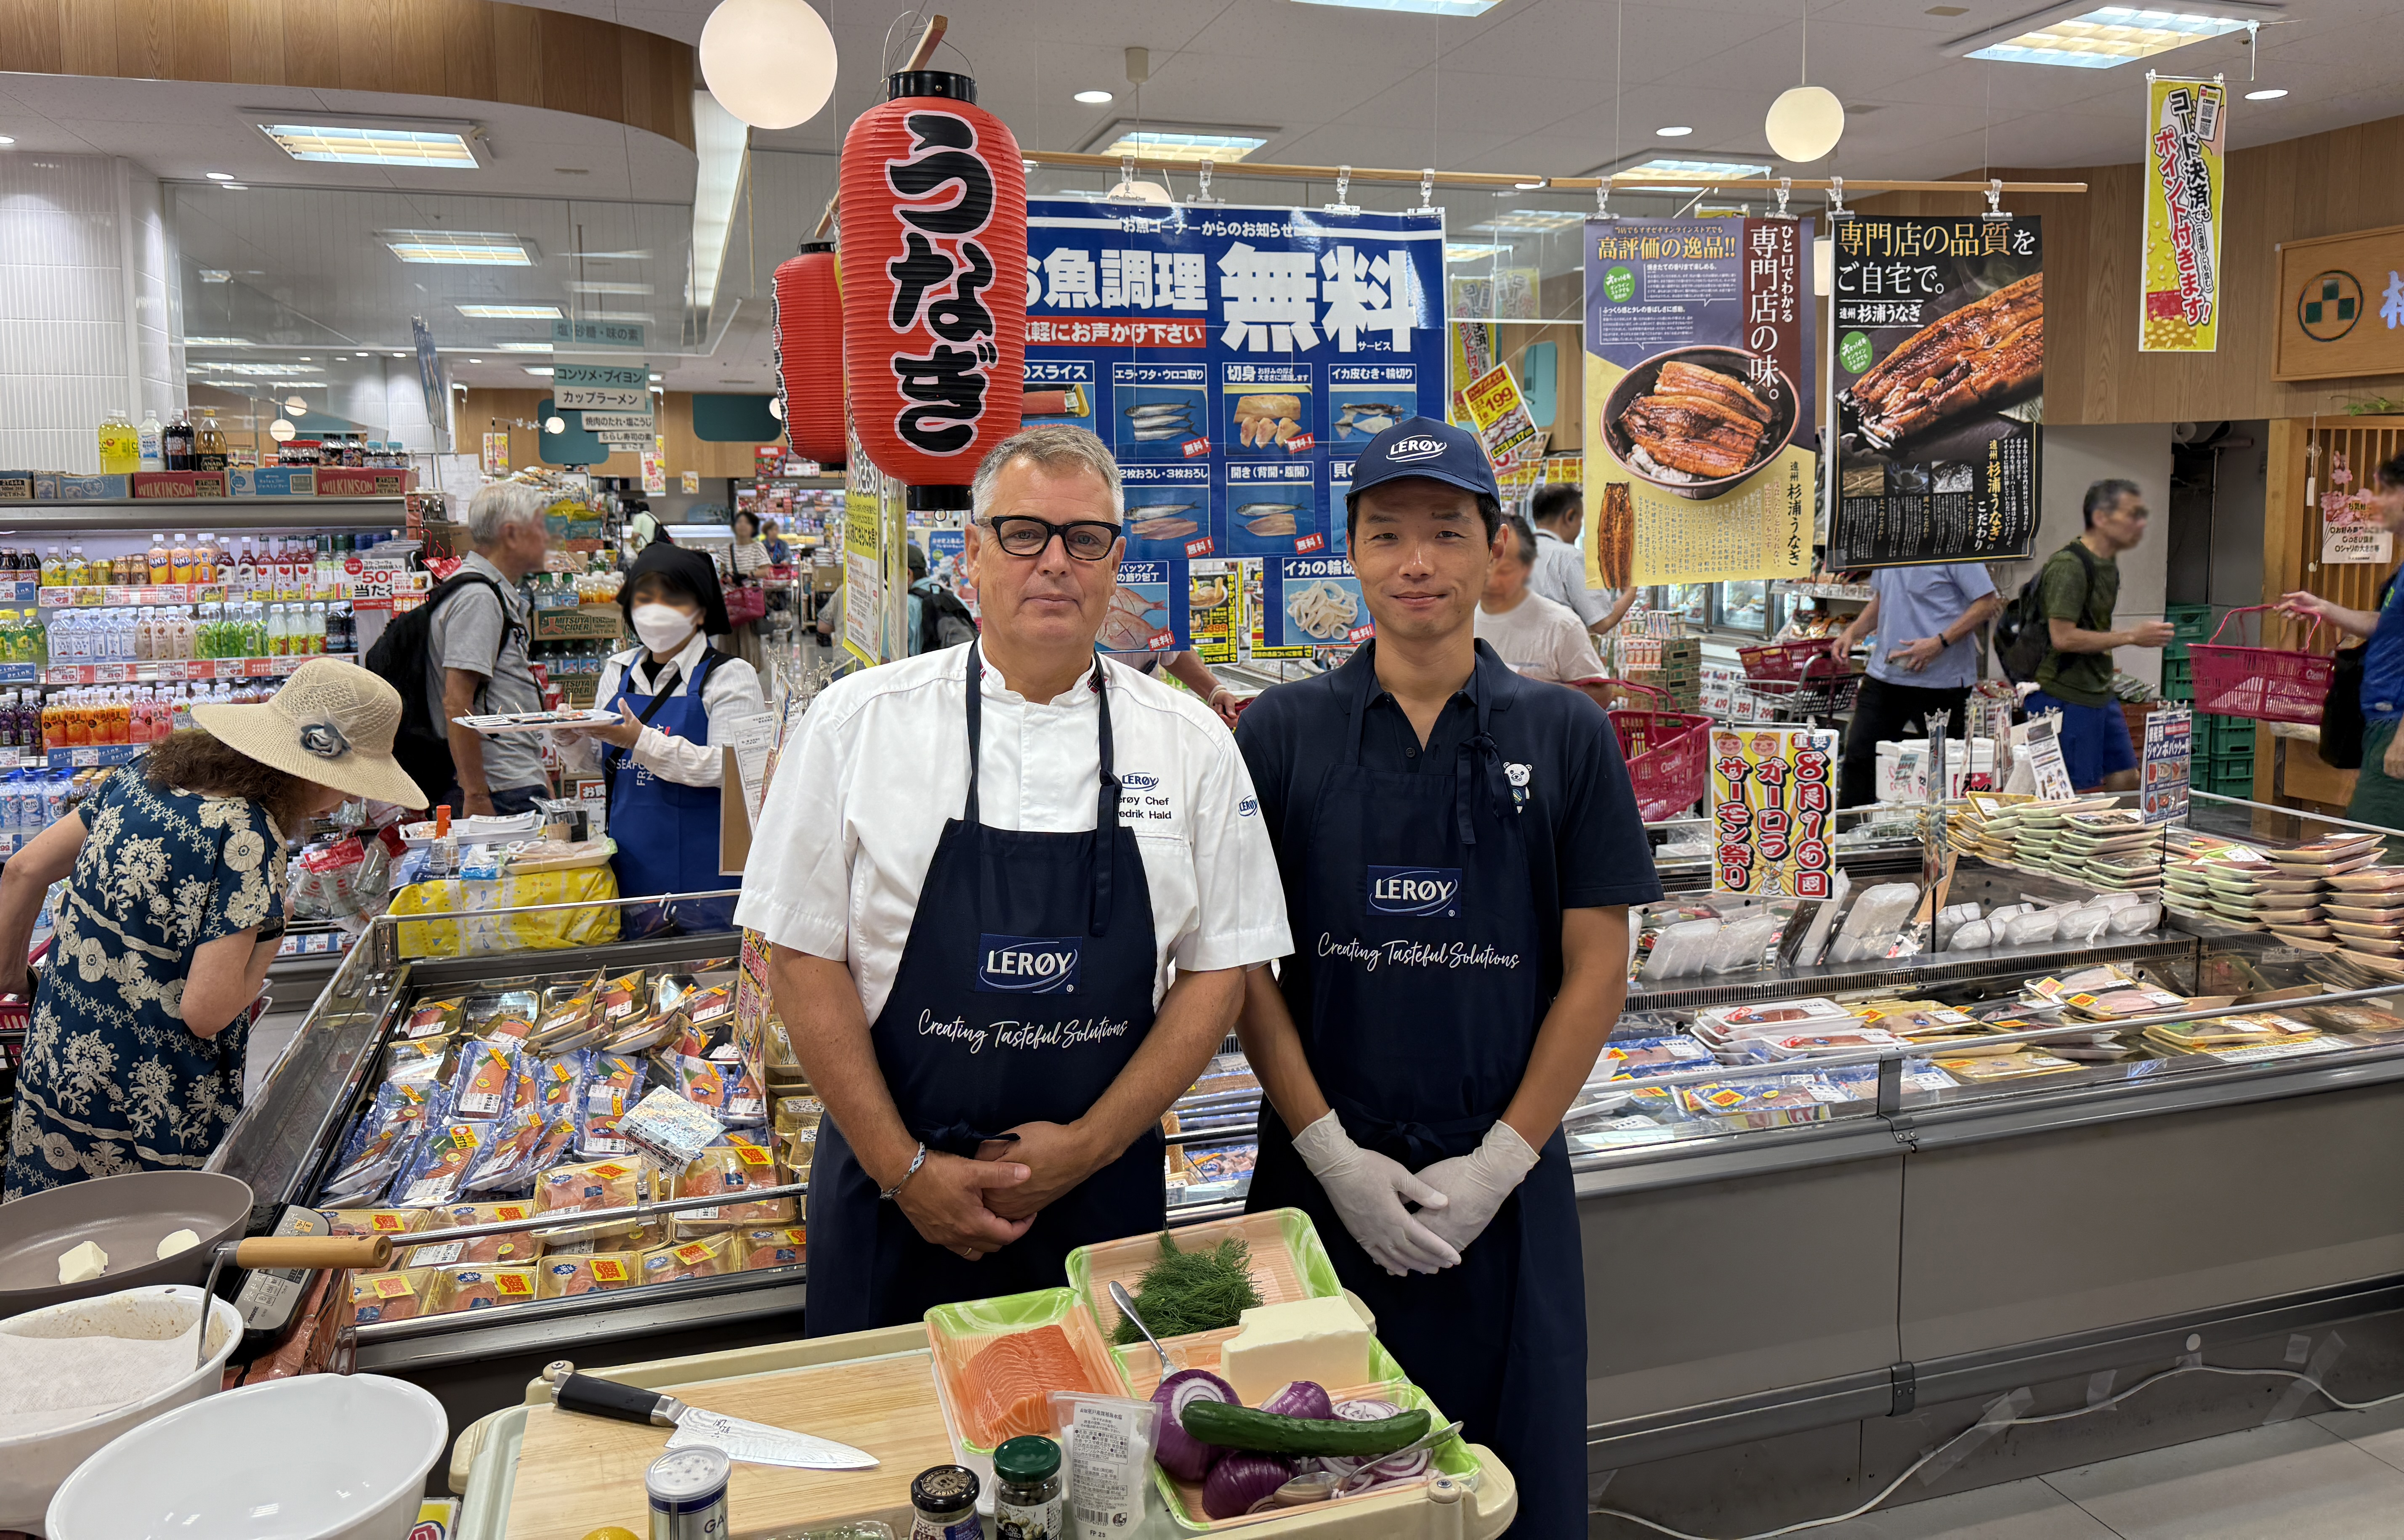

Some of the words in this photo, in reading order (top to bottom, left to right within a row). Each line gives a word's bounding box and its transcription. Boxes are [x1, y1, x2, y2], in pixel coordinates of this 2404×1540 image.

[1122, 219, 1294, 238] お魚コーナーからのお知らせ
[1838, 220, 2035, 257] 専門店の品質を
[1597, 236, 1736, 260] 高評価の逸品!!
[887, 112, 997, 454] うなぎ
[1781, 226, 1794, 323] ひと口でわかる
[1838, 260, 1944, 295] ご自宅で。
[1217, 242, 1418, 352] 無料
[1750, 226, 1780, 400] 専門店の味。
[1358, 341, 1391, 352] サービス
[558, 369, 642, 383] コンソメ・ブイヨン
[1114, 370, 1204, 381] エラ・ワタ・ウロコ取り
[1227, 365, 1256, 382] 切身
[1331, 367, 1413, 380] イカ皮むき・輪切り
[563, 390, 638, 405] カップラーメン
[1486, 387, 1514, 411] 199
[585, 417, 652, 428] 焼肉のたれ・塩こうじ
[1390, 440, 1444, 455] LERØY
[138, 481, 192, 497] WILKINSON
[322, 480, 373, 494] WILKINSON
[1974, 500, 1988, 552] こだわり
[1284, 563, 1357, 577] イカの輪切
[1793, 733, 1830, 749] 重要
[1122, 774, 1157, 787] LERØY
[1117, 795, 1140, 807] erøy
[1145, 796, 1169, 806] Chef
[1239, 797, 1258, 812] LERØY
[1758, 758, 1788, 859] オーロラ
[1119, 808, 1144, 819] edrik
[1149, 810, 1172, 820] Hald
[1718, 758, 1751, 887] サーモン祭り
[1375, 879, 1453, 901] LERØY
[1318, 932, 1382, 972] Creating
[1381, 940, 1448, 965] Tasteful
[1449, 942, 1520, 969] Solutions
[986, 950, 1077, 977] LERØY
[918, 1008, 989, 1054] Creating
[988, 1020, 1061, 1050] Tasteful
[1063, 1015, 1128, 1047] Solutions
